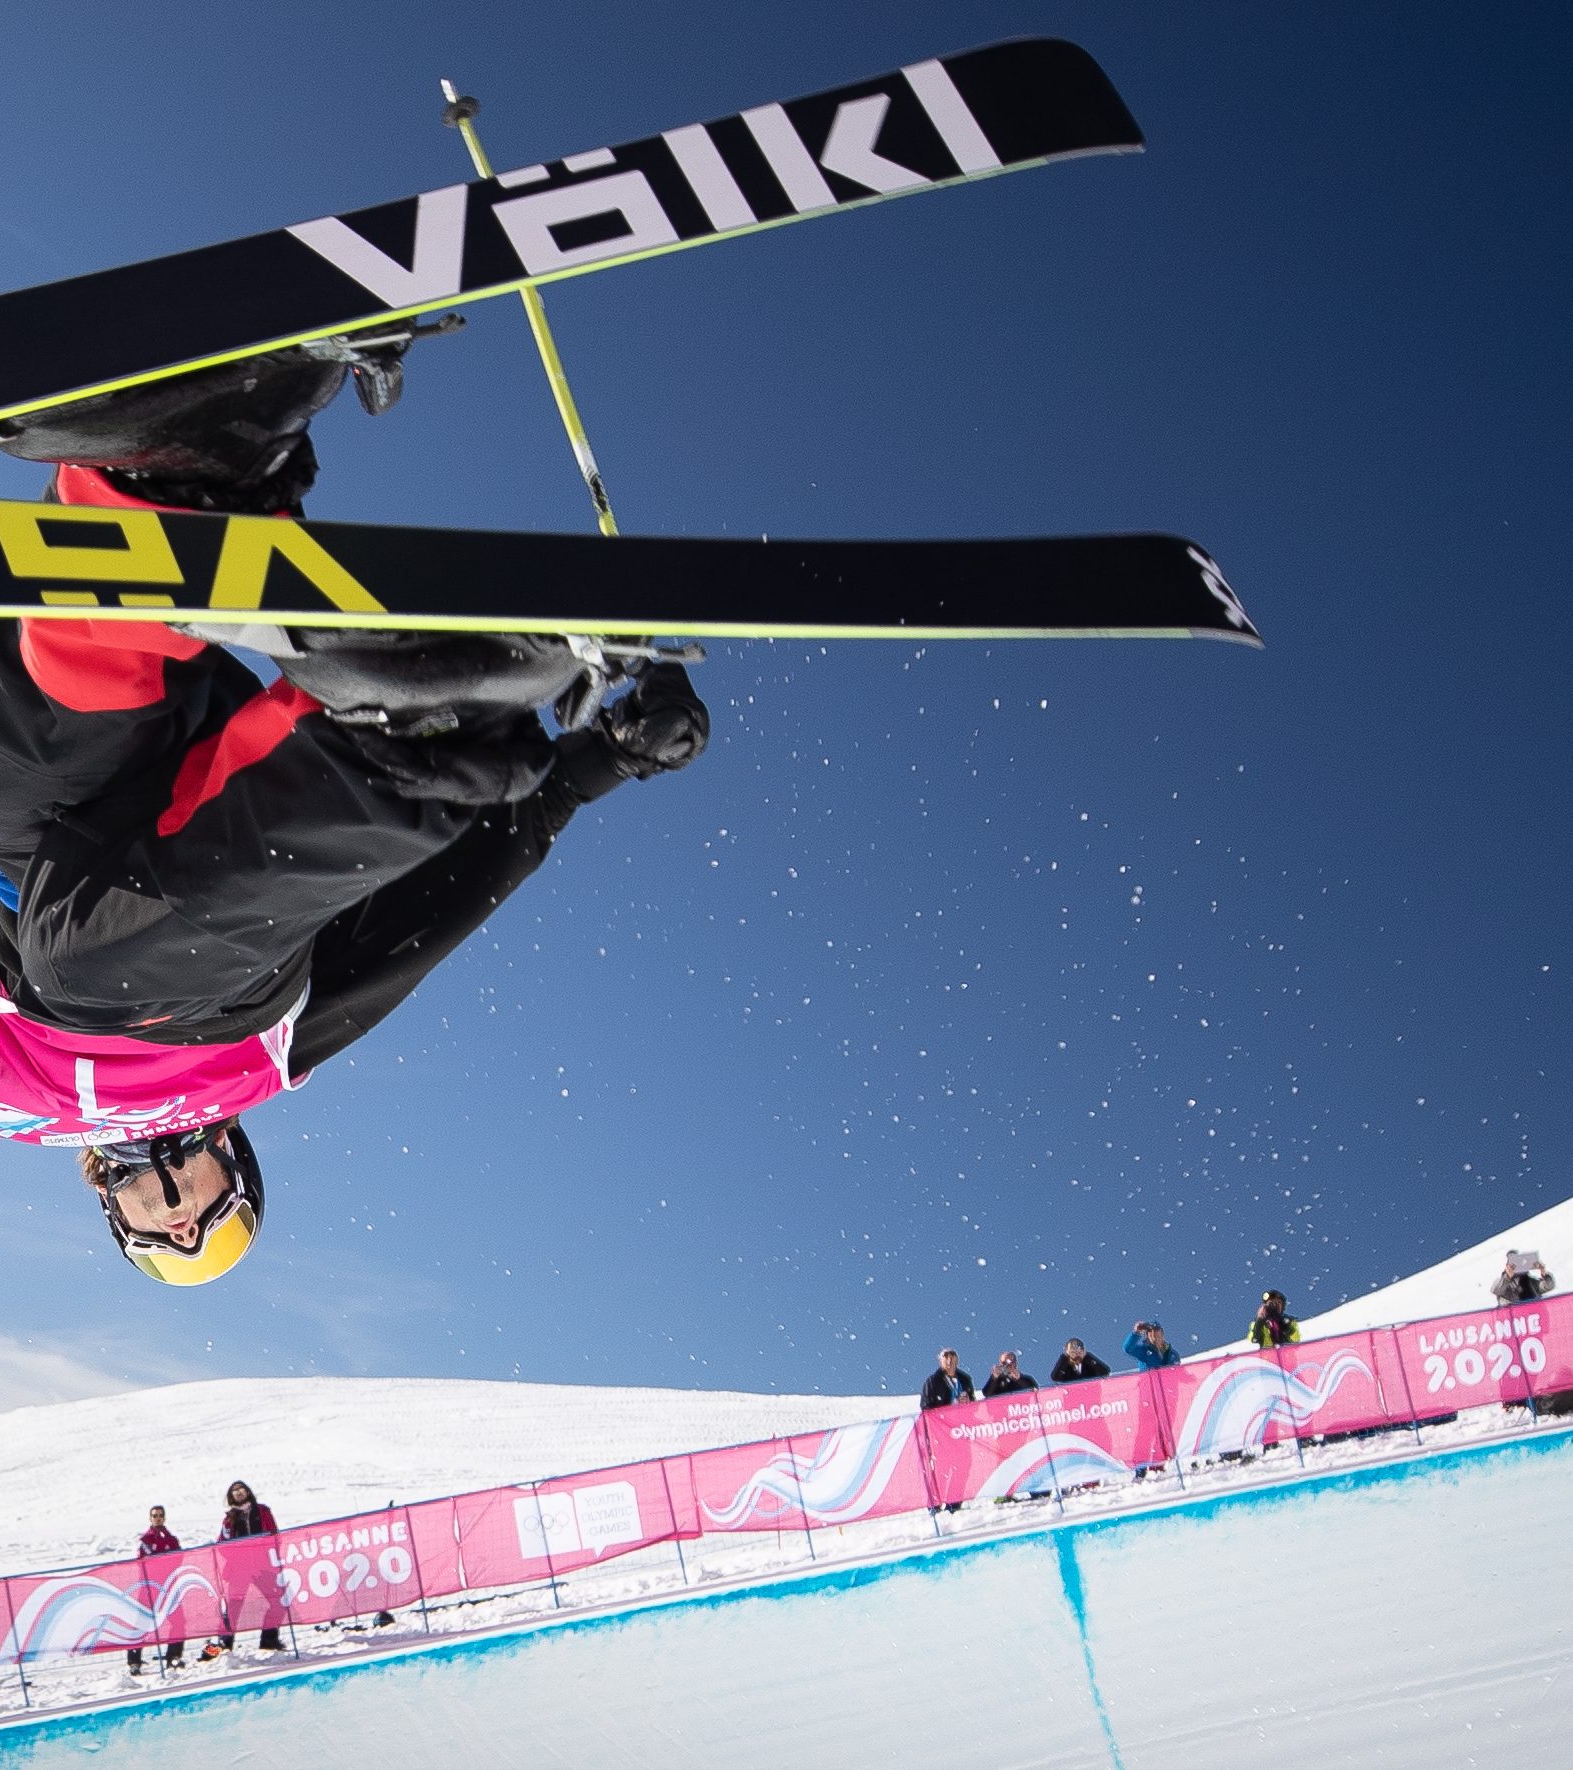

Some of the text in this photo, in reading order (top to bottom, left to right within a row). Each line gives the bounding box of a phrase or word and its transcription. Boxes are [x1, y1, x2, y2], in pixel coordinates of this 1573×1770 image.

[1419, 1313, 1541, 1354] LAUSANNE
[1045, 1398, 1062, 1410] on
[951, 1400, 1128, 1440] olympicchannel.com
[585, 1491, 625, 1506] YOUTH
[581, 1505, 633, 1522] OLYMPIC
[589, 1520, 631, 1537] GAMES
[268, 1521, 408, 1567] LAUSANNE
